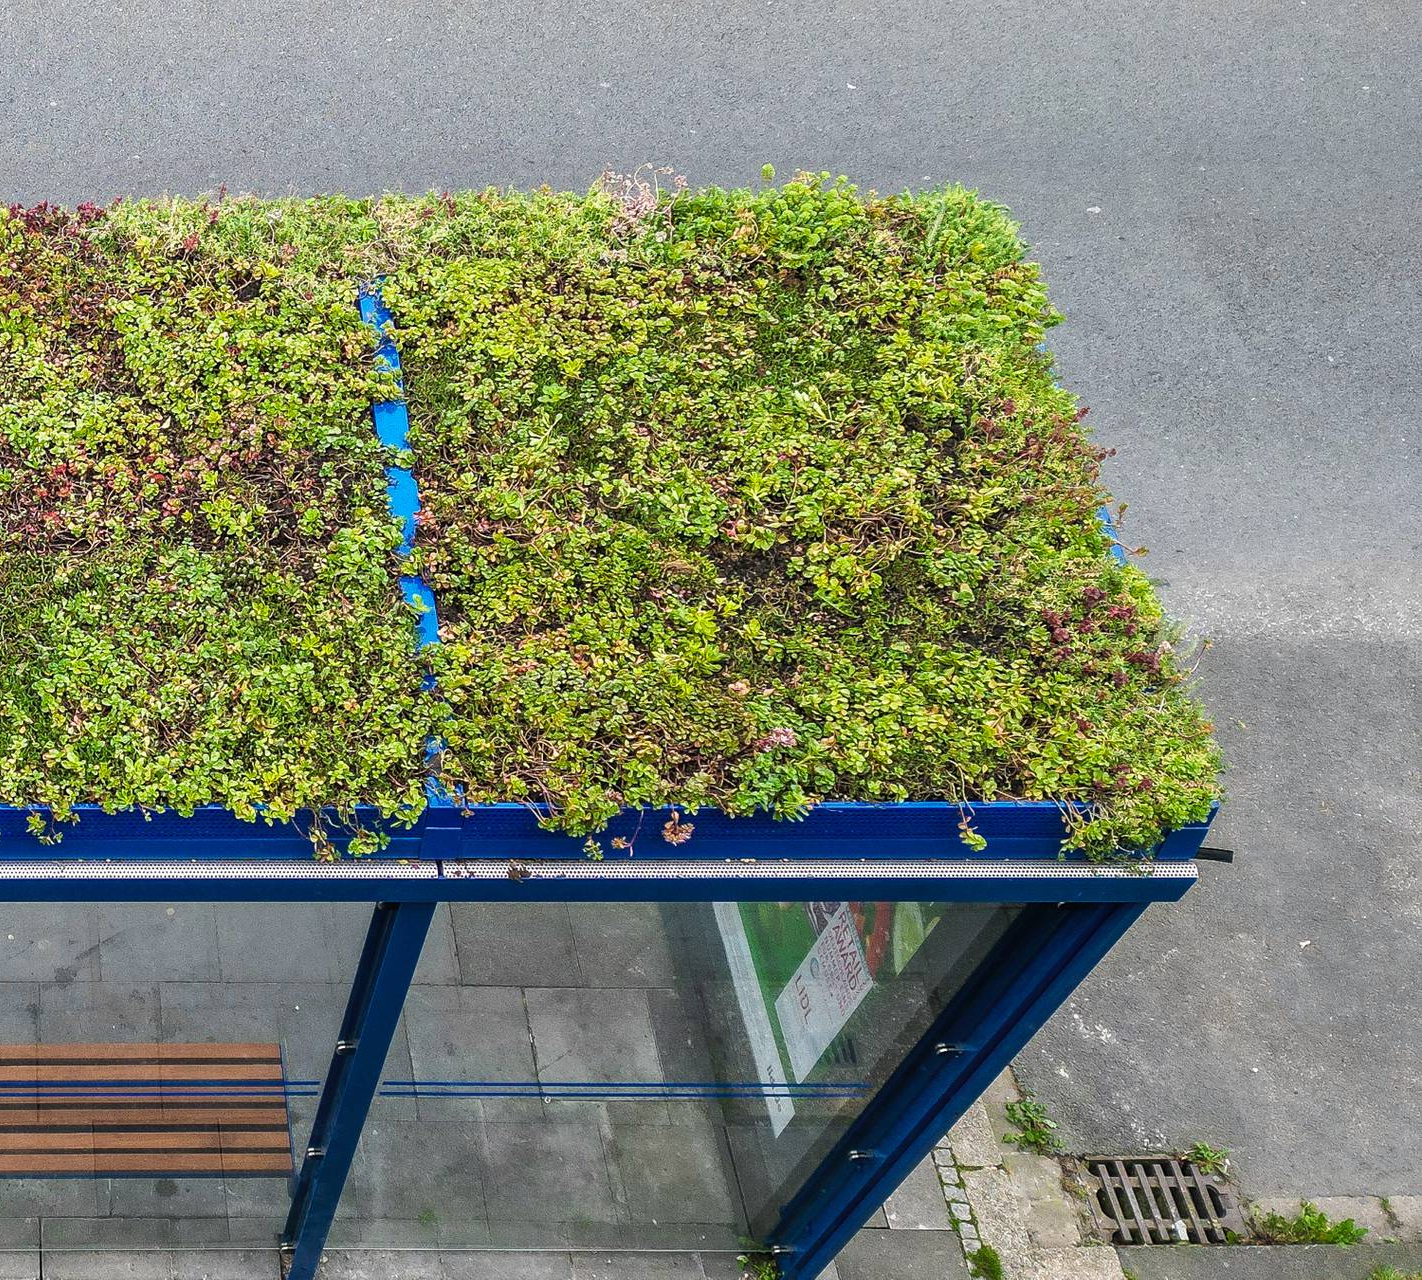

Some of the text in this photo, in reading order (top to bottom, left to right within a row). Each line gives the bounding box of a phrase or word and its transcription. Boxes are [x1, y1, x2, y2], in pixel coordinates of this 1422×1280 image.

[832, 925, 856, 990] AWARD
[839, 911, 862, 983] RETAIL
[795, 975, 811, 1024] LIDL
